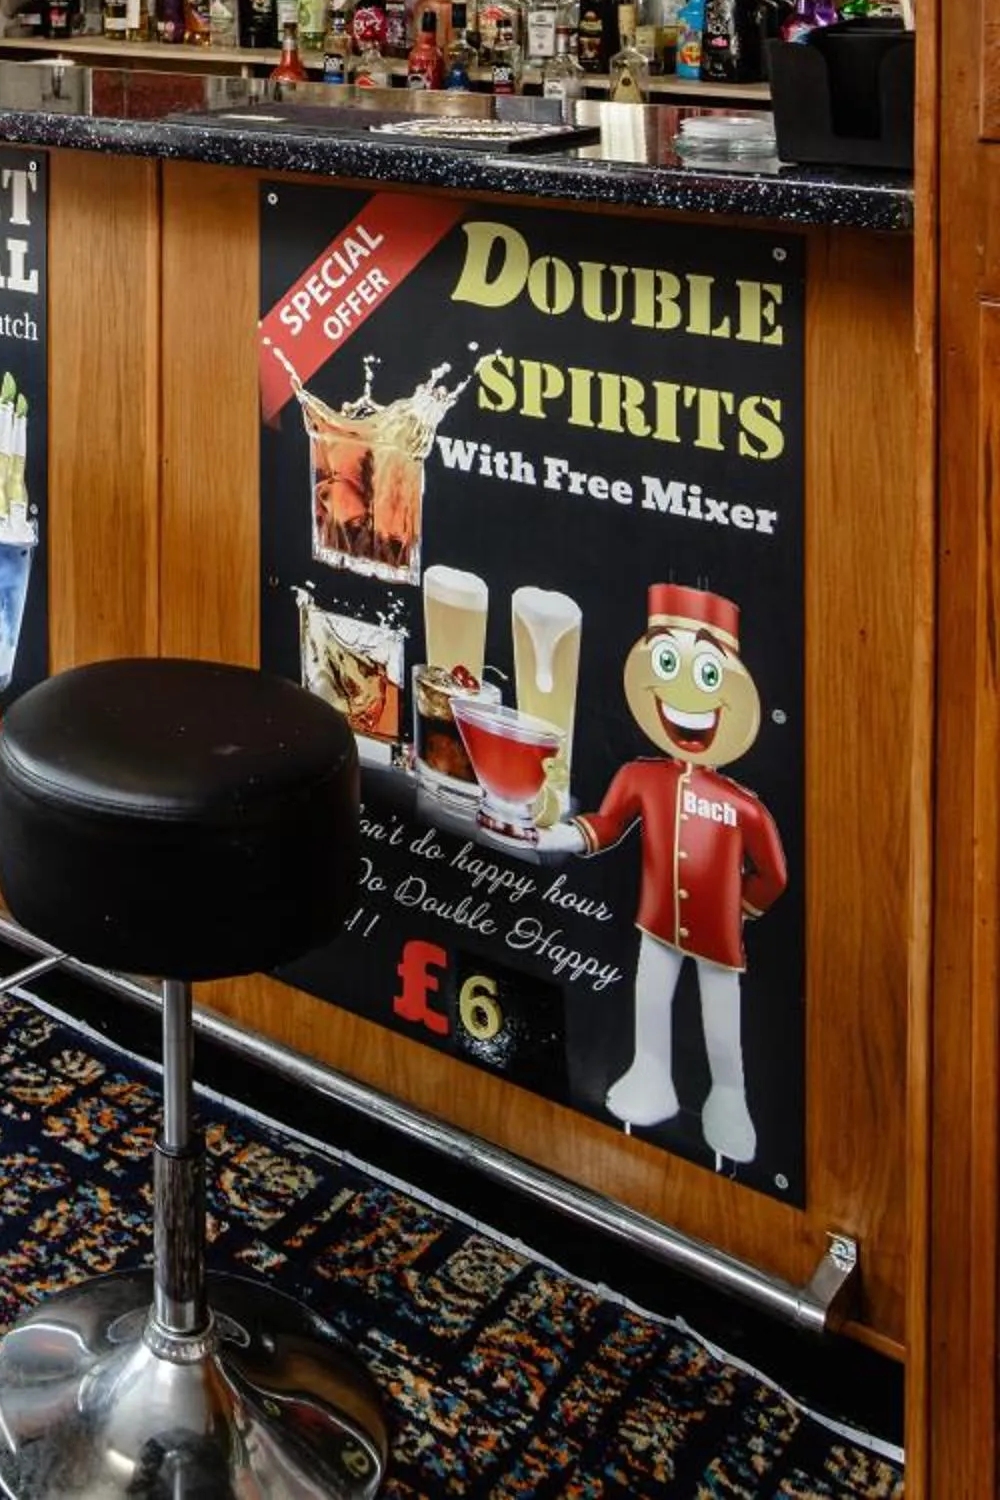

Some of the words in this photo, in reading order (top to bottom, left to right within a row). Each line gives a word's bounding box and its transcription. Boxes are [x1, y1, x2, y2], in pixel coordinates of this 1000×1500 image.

[278, 223, 385, 337] SPECIAL
[322, 268, 391, 342] OFFER
[451, 220, 784, 347] DOUBLE
[476, 352, 785, 460] SPIRITS
[435, 435, 536, 488] With
[542, 455, 634, 506] Free
[640, 475, 778, 535] Mixer
[358, 803, 403, 845] on't
[410, 827, 446, 860] do
[449, 842, 538, 901] happy
[542, 873, 614, 922] hour
[682, 789, 739, 829] Bach
[393, 875, 499, 935] Double
[505, 916, 624, 991] Happy
